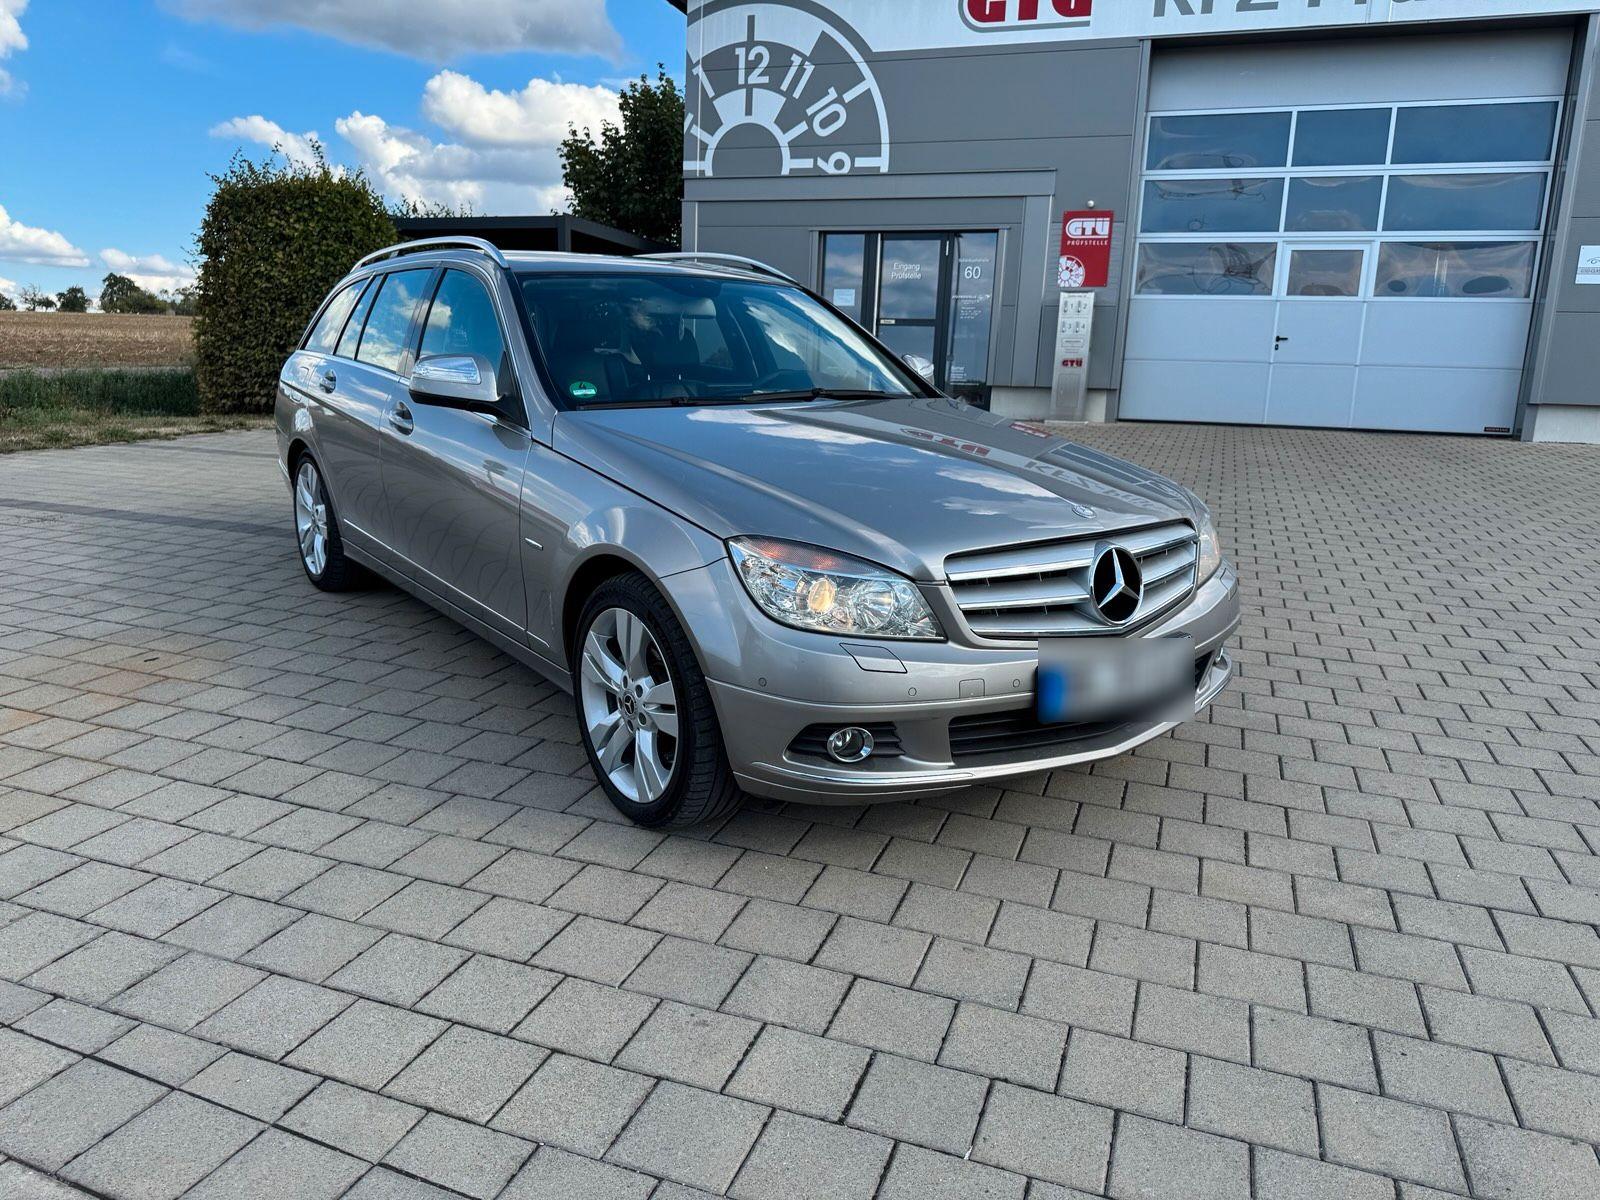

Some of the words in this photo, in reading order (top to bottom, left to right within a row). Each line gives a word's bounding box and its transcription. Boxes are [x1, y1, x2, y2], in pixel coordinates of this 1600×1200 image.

[735, 45, 770, 85] 12
[780, 53, 816, 100] 11
[805, 86, 847, 137] 10
[1067, 218, 1110, 237] GTÜ
[1066, 239, 1109, 247] PRÜFSTELLE
[893, 262, 921, 272] Eingang
[964, 266, 981, 279] 60
